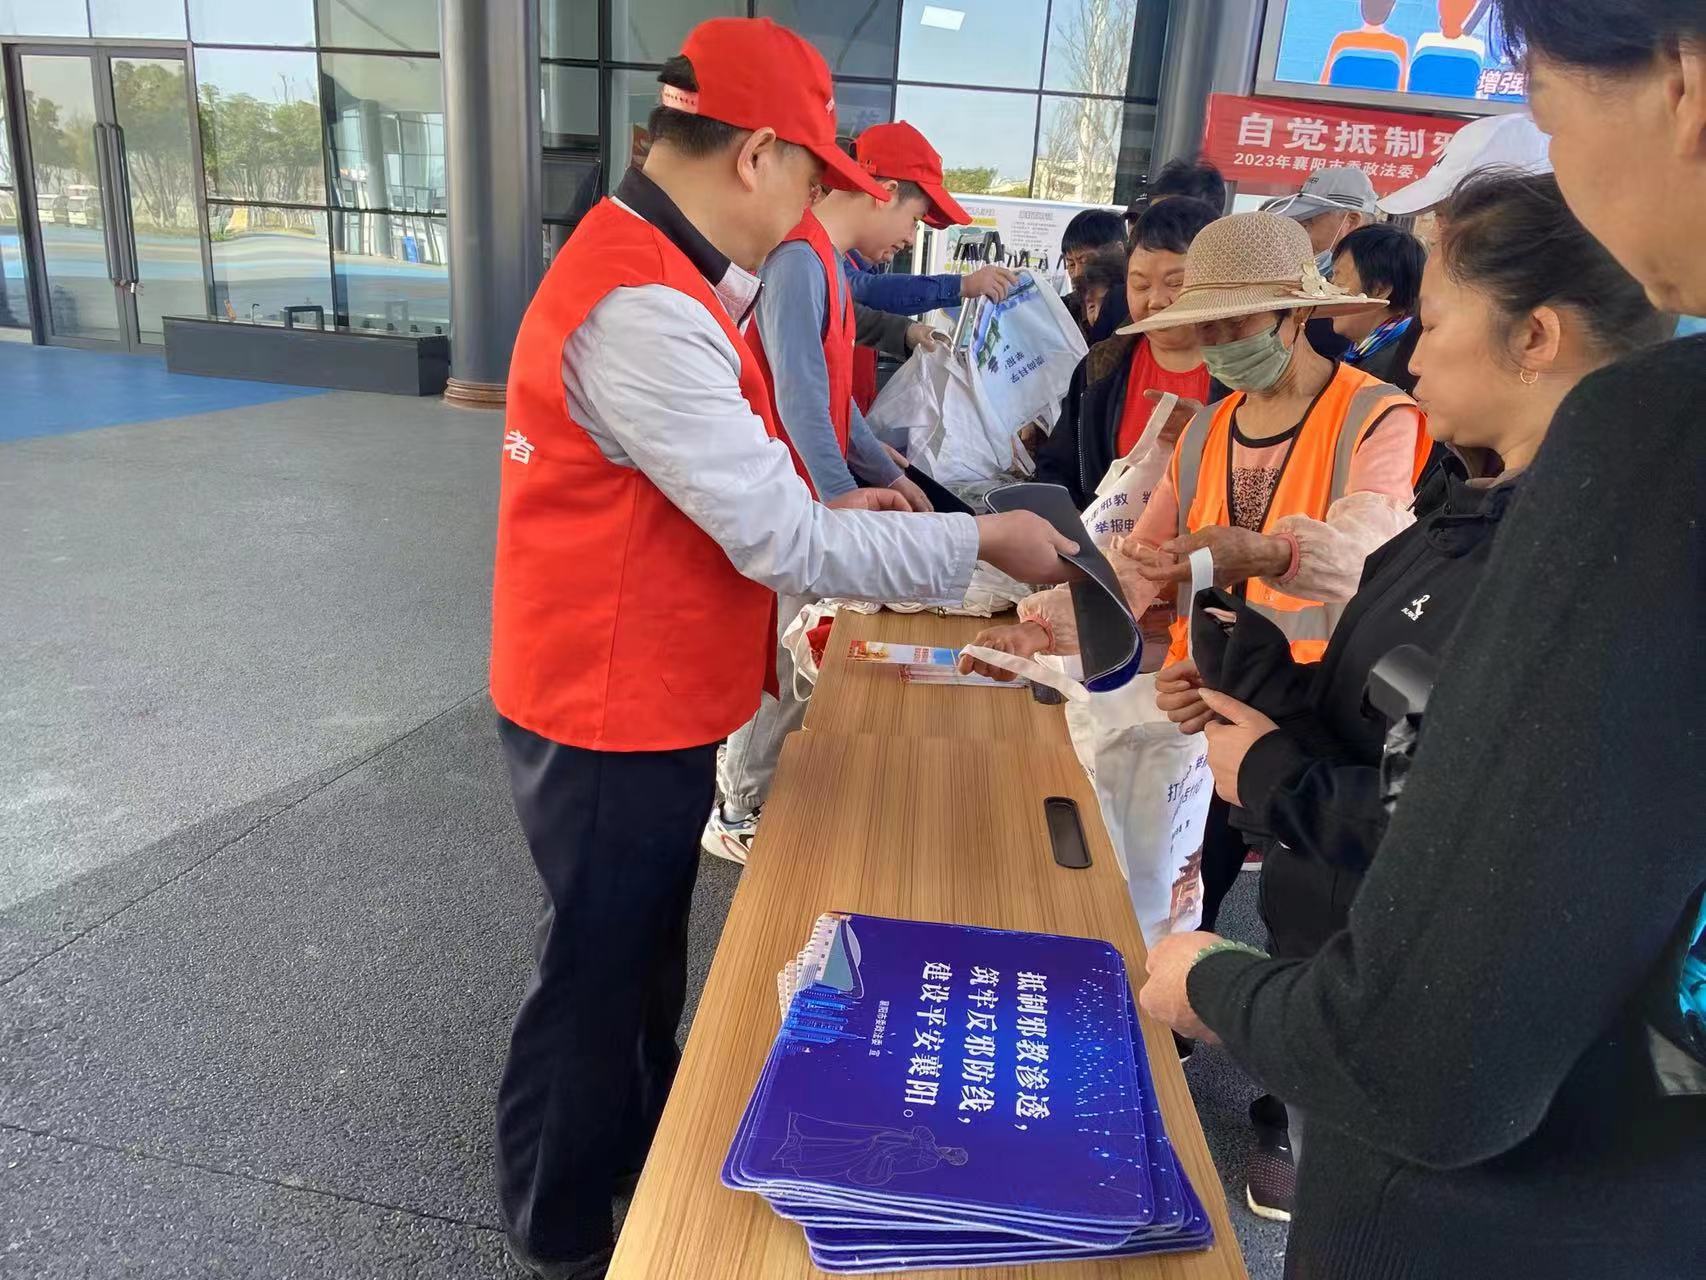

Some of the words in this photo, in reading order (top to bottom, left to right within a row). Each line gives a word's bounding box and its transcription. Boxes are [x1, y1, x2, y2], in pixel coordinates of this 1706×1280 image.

[1477, 70, 1525, 96] 增强
[504, 429, 536, 464] 者
[903, 960, 952, 1118] 建设平安襄阳。
[957, 965, 1000, 1124] 筑牢反邪防线，
[1015, 970, 1051, 1130] 抵制邪教渗透，
